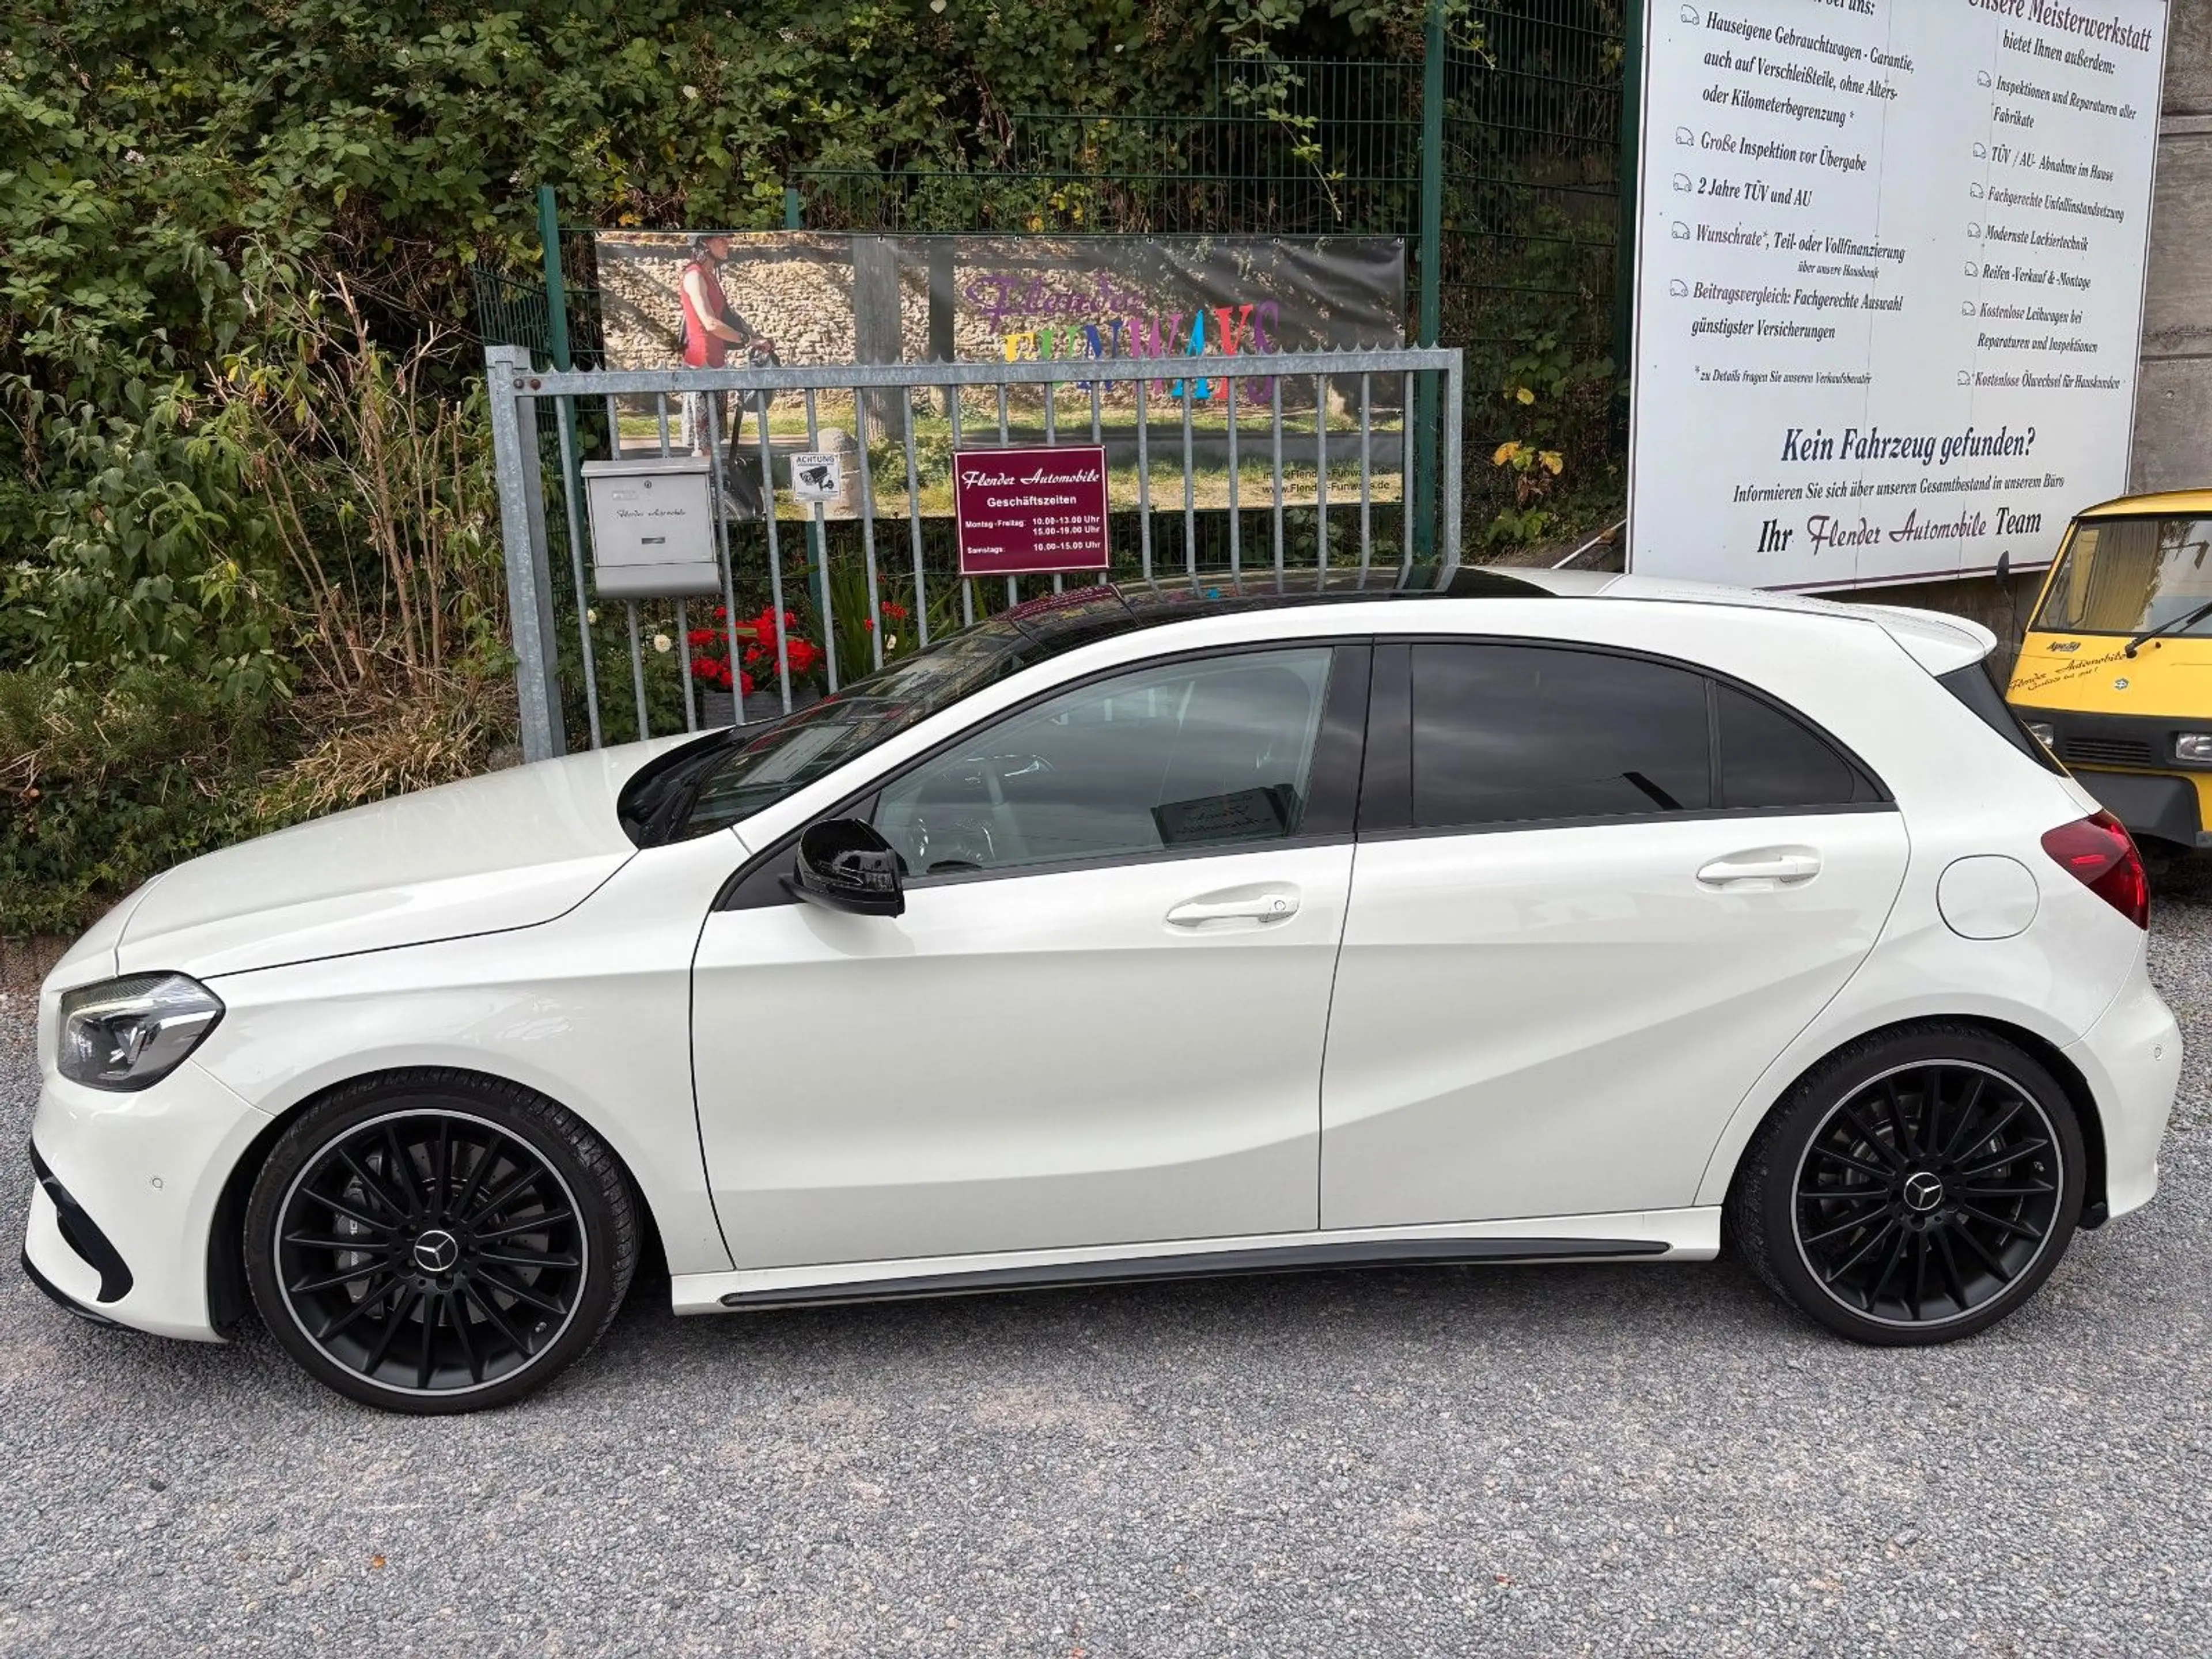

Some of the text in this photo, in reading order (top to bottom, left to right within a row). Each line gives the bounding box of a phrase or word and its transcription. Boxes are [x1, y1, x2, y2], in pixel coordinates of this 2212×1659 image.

[2028, 0, 2152, 52] Meisterwerkstatt
[1706, 12, 1772, 41] Hauseigene
[1775, 26, 1862, 60] Gebrauchtwagen
[1870, 47, 1915, 73] Garantie,
[2003, 29, 2116, 74] bietet Ihnen außerdem:
[1703, 50, 1732, 69] auch
[1734, 55, 1755, 73] auf
[1758, 58, 1836, 90] Verschleißteile,
[1840, 74, 1864, 94] ohne
[1703, 85, 1846, 128] oder Kilometerbegrenzung
[1997, 75, 2137, 120] Inspektionen und Reparaturen aller
[1993, 107, 2035, 128] Fabrikate
[1701, 131, 1867, 172] Große Inspektion vor Übergabe
[1992, 143, 2011, 164] TÜV
[2039, 155, 2077, 175] Abnahme
[2078, 163, 2089, 177] im
[2090, 164, 2114, 181] Hause
[1698, 177, 1812, 207] 2 Jahre TÜV und AU
[1988, 186, 2124, 224] Fachgerechte Unfallinstandsetzung
[1774, 232, 1797, 250] Teil-
[1798, 236, 1822, 253] oder
[1825, 238, 1906, 263] Vollfinanzierung
[1986, 225, 2088, 252] Modernste Lackiertechnik
[1983, 264, 2010, 281] Reifen
[1693, 281, 1903, 311] Beitragsvergleich: Fachgerechte Auswahl
[1979, 302, 2025, 320] Kostenlose
[2070, 309, 2083, 324] bei
[1691, 317, 1835, 342] günstigster Versicherungen
[1977, 332, 2030, 350] Reparaturen
[2032, 336, 2048, 350] und
[1713, 369, 1740, 382] Details
[1770, 370, 1782, 382] Sie
[1975, 372, 2019, 387] Kostenlose
[1781, 426, 2036, 465] Kein Fahrzeug gefunden?
[962, 468, 1100, 489] Flender Automobile
[1733, 473, 2064, 503] Informieren Sie sich über unseren Gesamtbestand in unserem Büro
[987, 495, 1077, 507] Geschäftszeiten
[1084, 516, 1100, 524] Uhr
[1085, 526, 1100, 534] Uhr
[1758, 507, 2041, 556] Ihr Flender Automobile Team
[1085, 541, 1101, 550] Uhr
